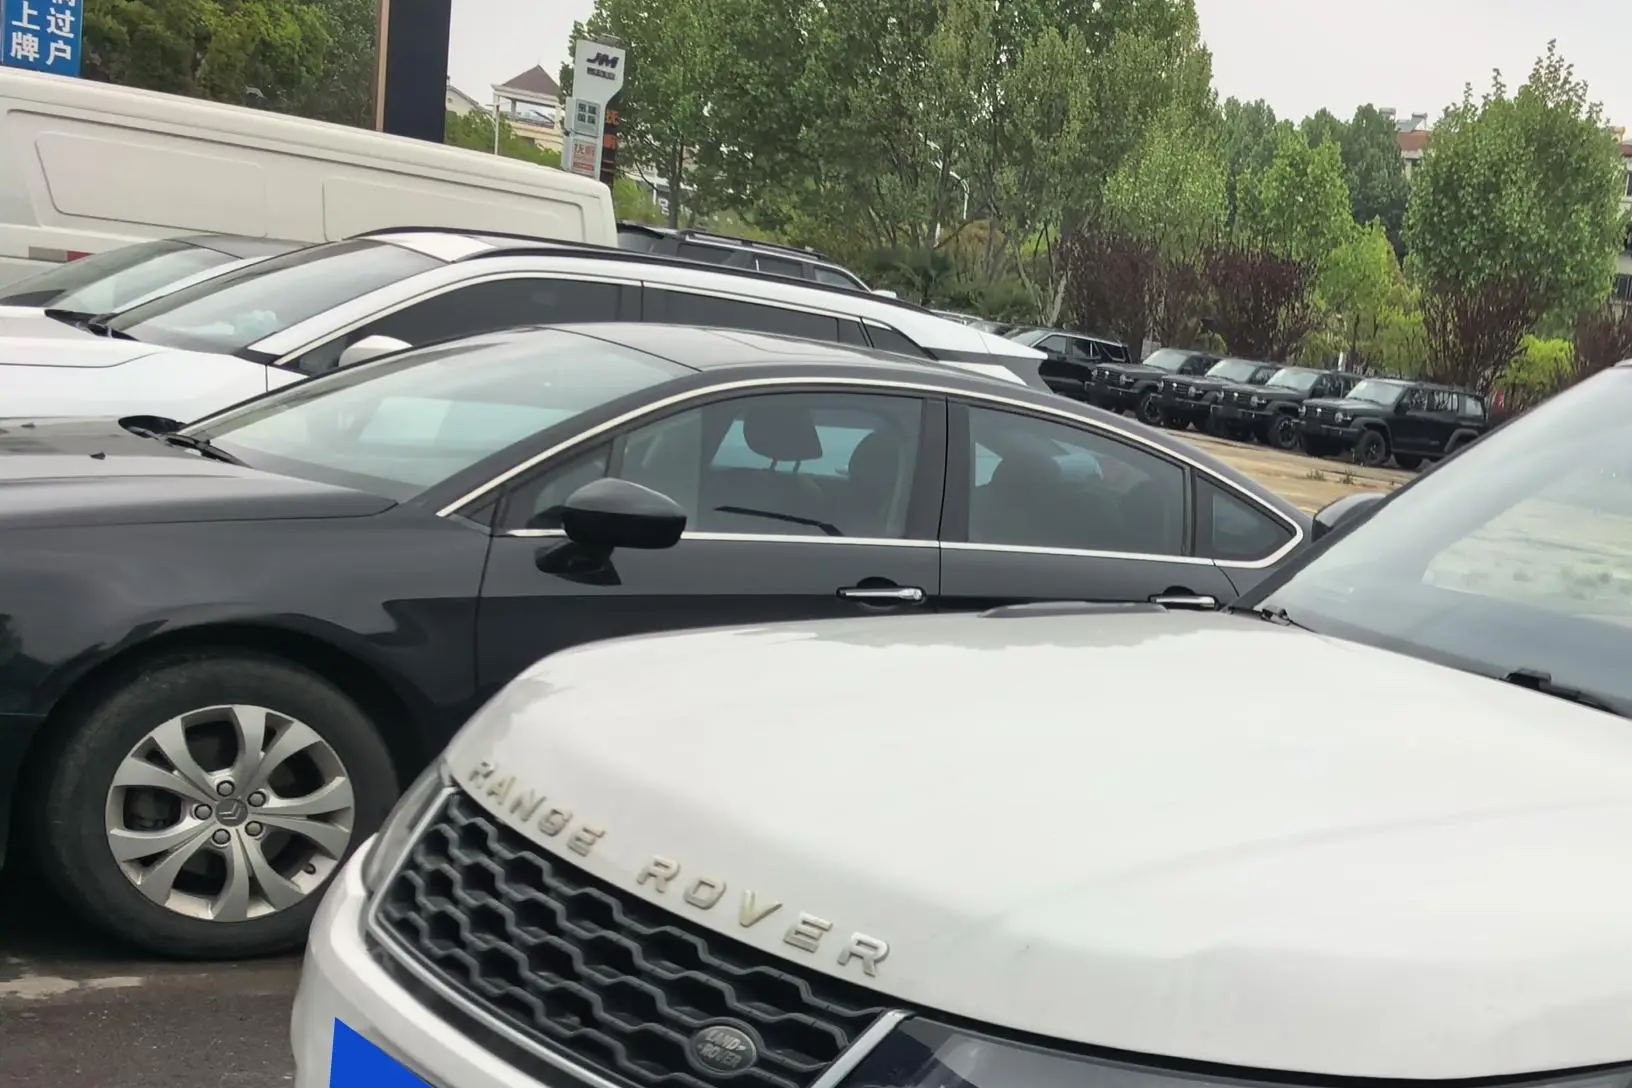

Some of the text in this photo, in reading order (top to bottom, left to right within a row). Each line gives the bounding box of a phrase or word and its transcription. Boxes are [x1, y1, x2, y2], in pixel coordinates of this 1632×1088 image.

[46, 0, 75, 65] 过户
[467, 760, 890, 977] RANGE ROVER
[705, 1029, 742, 1051] LAND
